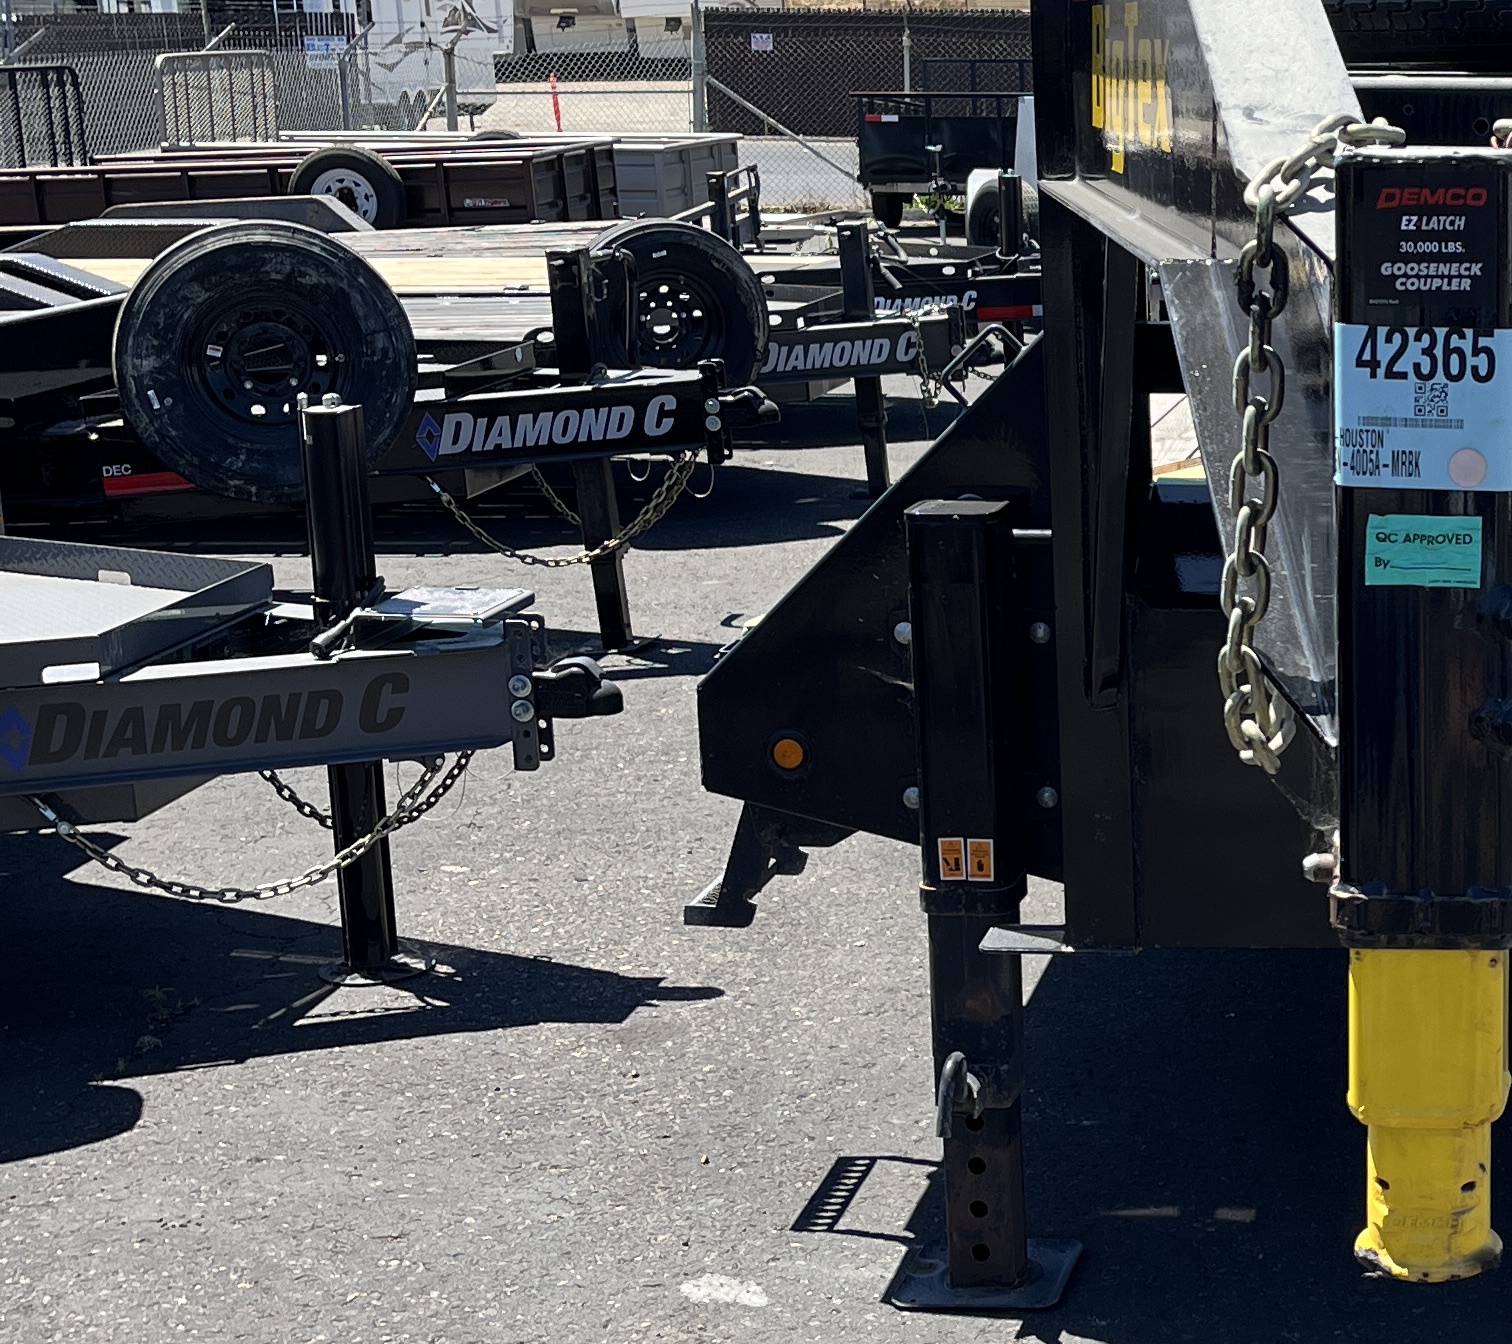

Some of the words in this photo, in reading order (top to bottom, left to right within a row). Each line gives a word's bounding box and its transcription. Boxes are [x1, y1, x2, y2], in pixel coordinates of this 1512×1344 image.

[1375, 187, 1488, 210] DEMCO
[1400, 215, 1419, 230] EZ
[1420, 215, 1466, 230] LATCH
[1399, 241, 1439, 254] 30,000
[1441, 241, 1466, 253] LBS.
[1380, 262, 1483, 276] GOOSENECK
[1395, 277, 1471, 291] COUPLER
[896, 331, 919, 363] C
[1355, 325, 1496, 384] 42365
[438, 406, 635, 456] DIAMOND
[643, 394, 677, 437] C
[102, 463, 132, 477] DEC
[1375, 532, 1399, 544] QC
[1402, 533, 1473, 546] APPROVED
[1374, 556, 1391, 570] By
[28, 688, 344, 766] DIAMOND
[359, 672, 410, 733] C
